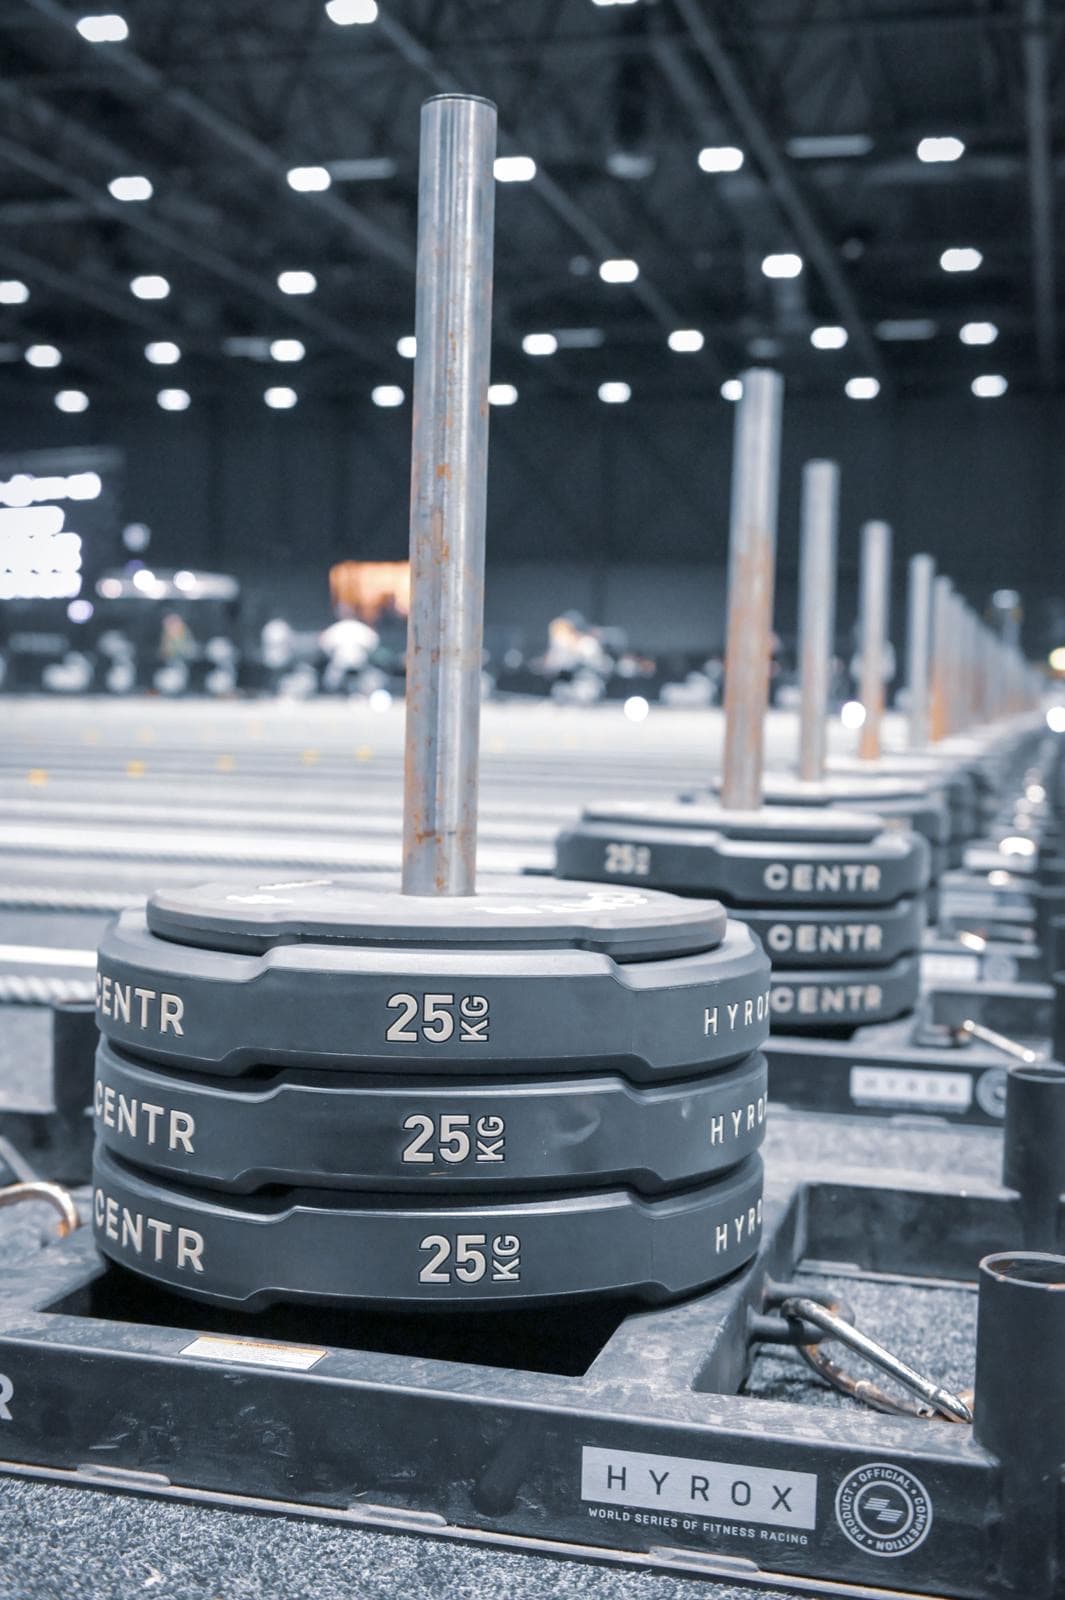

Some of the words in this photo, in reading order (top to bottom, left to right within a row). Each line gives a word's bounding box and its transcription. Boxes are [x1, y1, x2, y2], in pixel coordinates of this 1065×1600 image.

[763, 864, 882, 892] CENTR
[768, 924, 883, 952] CENTR
[385, 992, 455, 1043] 25
[459, 995, 490, 1042] KG
[769, 985, 883, 1014] CENTR
[94, 1080, 196, 1154] CENTR
[401, 1113, 471, 1164] 25
[475, 1115, 505, 1162] KG
[94, 1188, 205, 1273] CENTR
[418, 1233, 488, 1285] 25
[492, 1234, 520, 1282] KG
[607, 1464, 792, 1513] HYROX
[858, 1468, 911, 1489] OFFICIAL
[588, 1507, 631, 1522] WORLD
[634, 1513, 678, 1528] SERIES
[683, 1519, 699, 1530] OF
[703, 1522, 756, 1539] FITNESS
[760, 1530, 808, 1546] RACING
[842, 1487, 867, 1541] PRODUCT
[875, 1497, 927, 1551] COMPETITION
